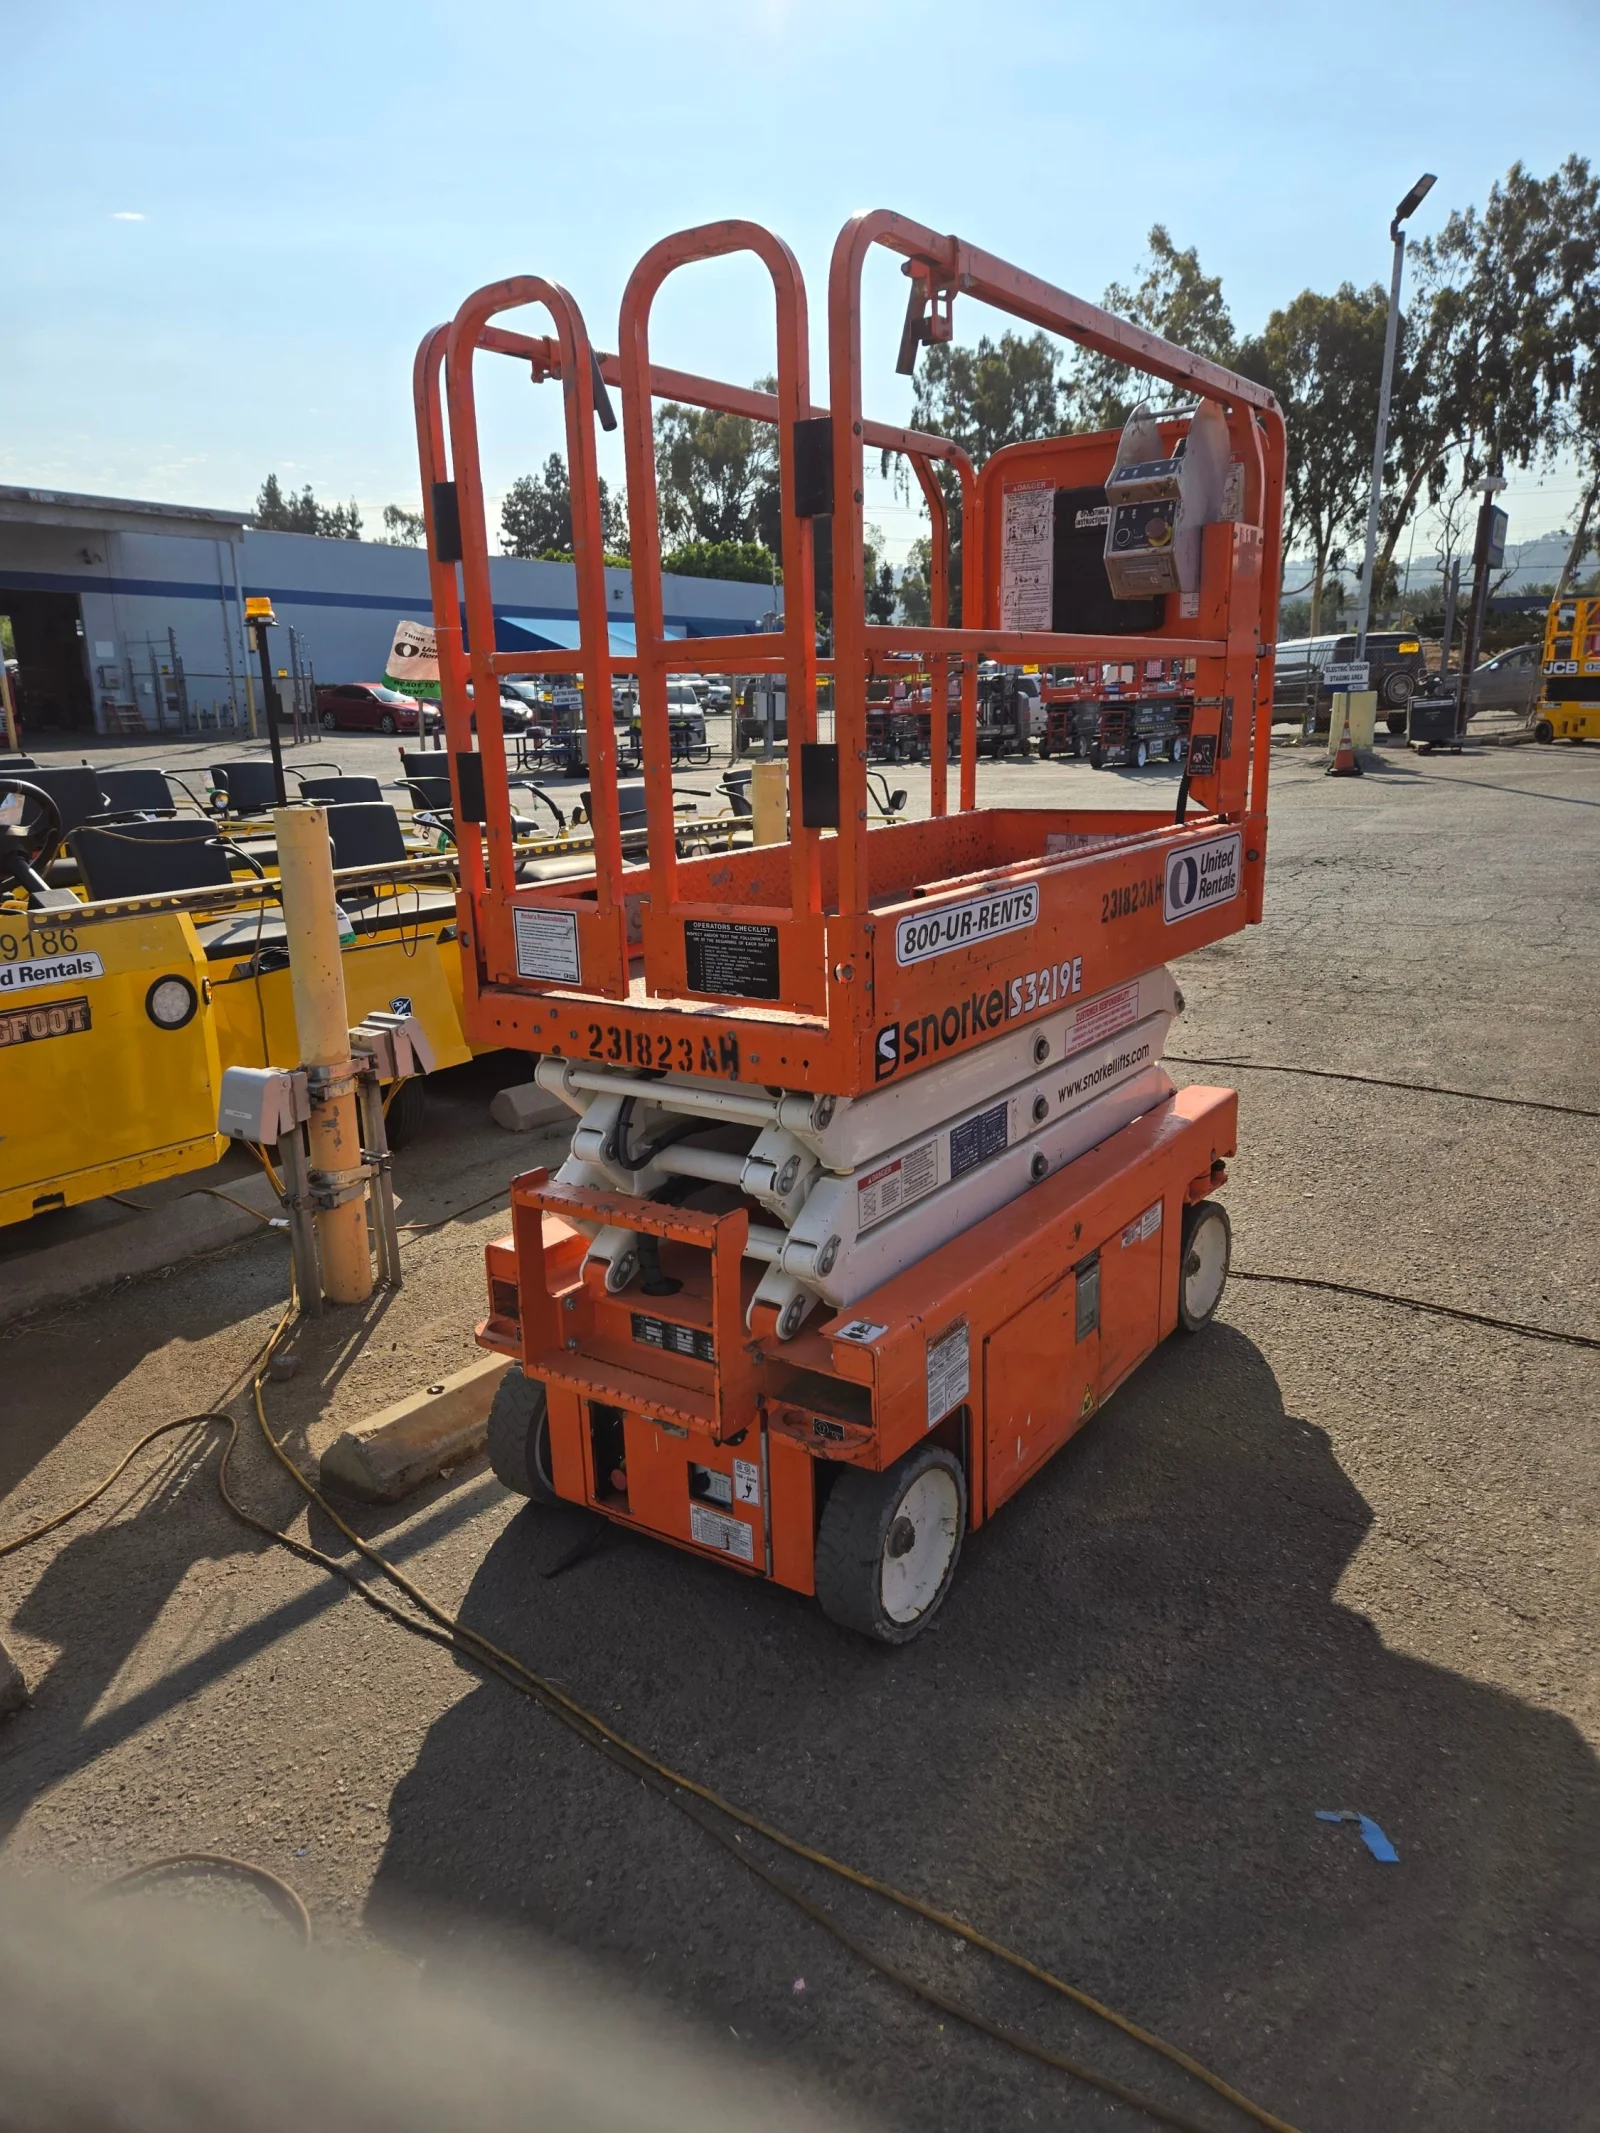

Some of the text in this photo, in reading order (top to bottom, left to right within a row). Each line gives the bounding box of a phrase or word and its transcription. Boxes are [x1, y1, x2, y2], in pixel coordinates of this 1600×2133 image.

[404, 631, 426, 642] THINK
[1326, 665, 1348, 673] ELECTRIC
[1543, 661, 1578, 675] JCB
[1200, 844, 1234, 875] United
[1199, 869, 1236, 900] Rentals
[693, 922, 771, 934] OPERATORS CHECKLIST
[904, 892, 1033, 954] 800-UR-RENTS
[19, 958, 93, 983] Rentals
[588, 1023, 739, 1076] 231823AH
[1058, 1043, 1149, 1103] www.snorkellifts.com
[871, 1165, 892, 1182] DANGER
